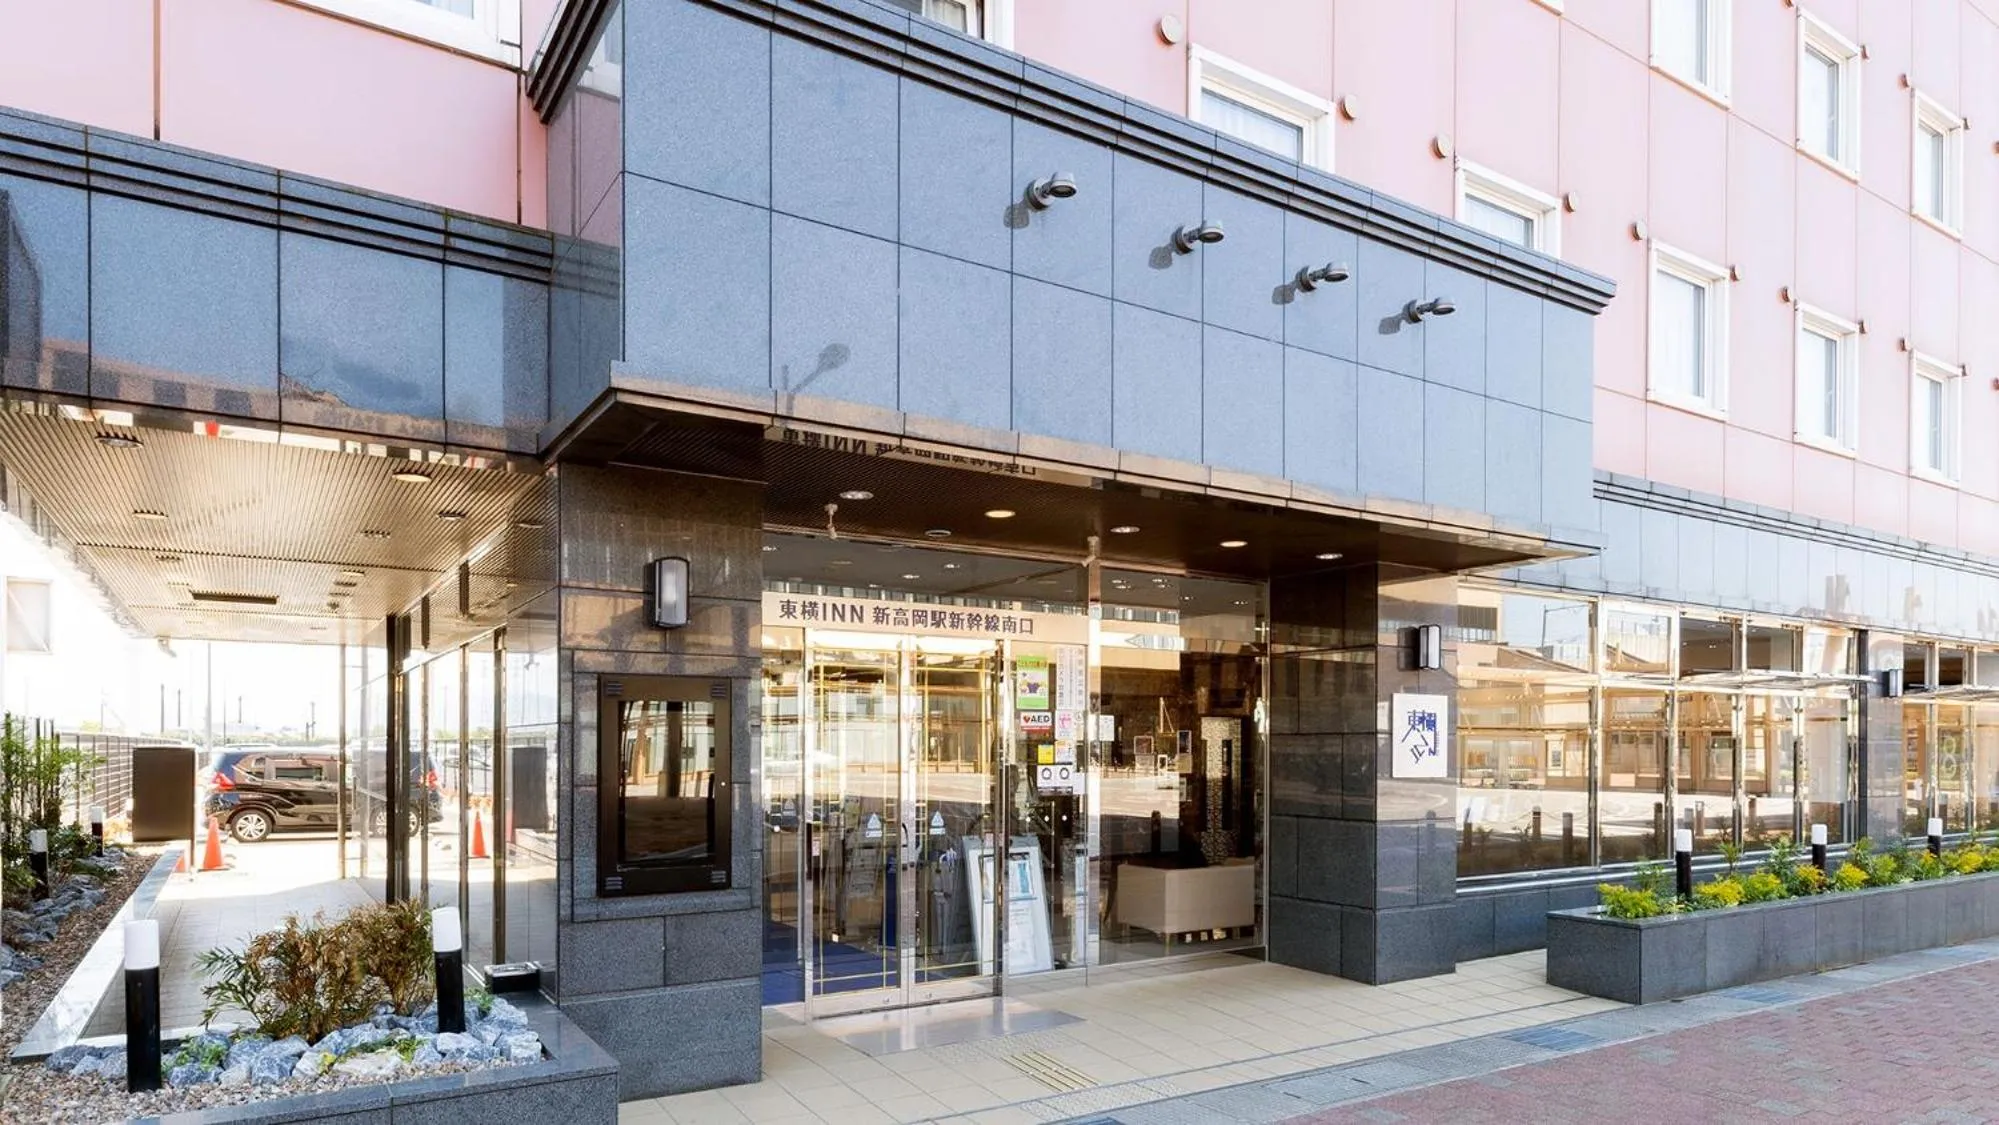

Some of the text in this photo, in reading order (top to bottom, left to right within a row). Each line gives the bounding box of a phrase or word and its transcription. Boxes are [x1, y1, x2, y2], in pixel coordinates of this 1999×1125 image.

[779, 598, 1034, 635] 東横INN 新高岡駅新幹線南口
[1031, 715, 1050, 723] AED
